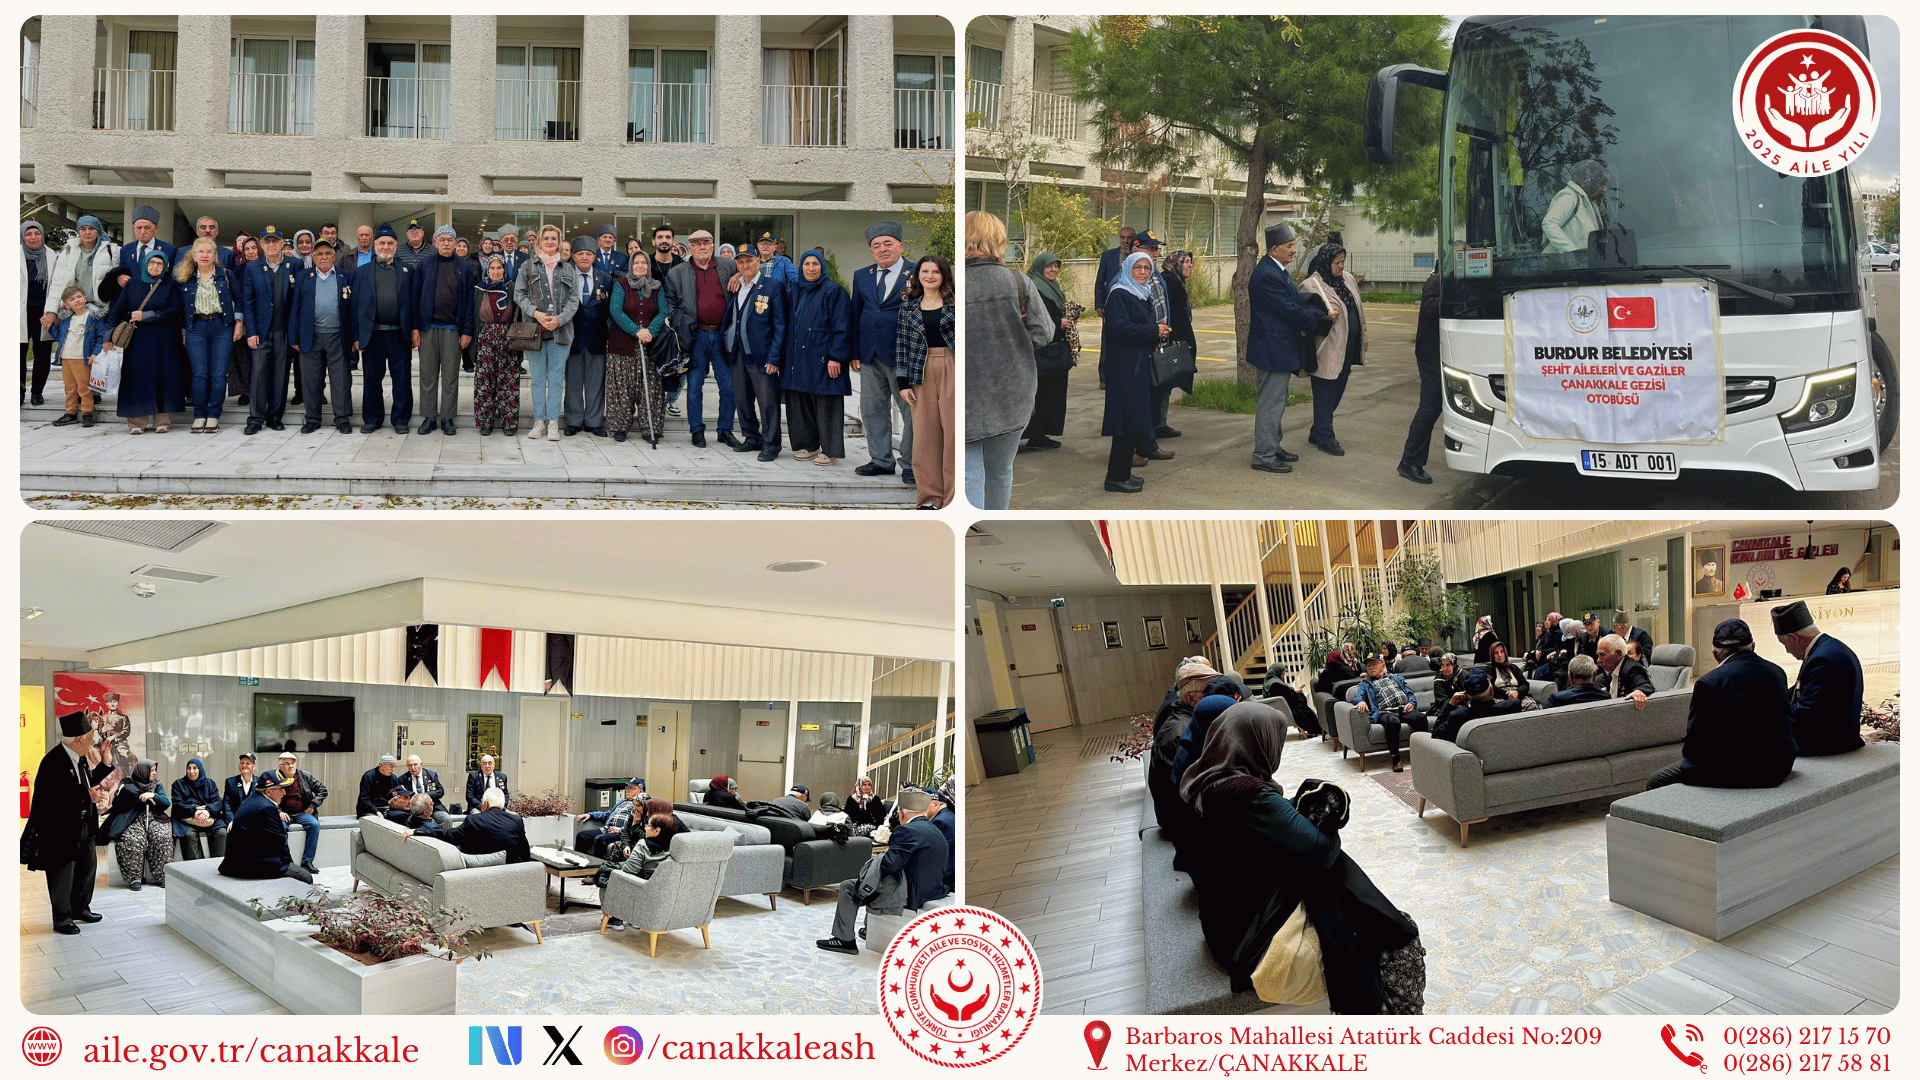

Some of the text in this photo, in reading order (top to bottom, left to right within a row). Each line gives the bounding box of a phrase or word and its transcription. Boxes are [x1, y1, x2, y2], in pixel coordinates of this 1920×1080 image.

[1534, 342, 1693, 361] BURDUR BELEDİYESİ
[1541, 362, 1686, 377] ŞEHİT AİLELERİ VE GAZİLER
[1561, 378, 1666, 391] ÇANAKKALE GEZİSİ
[1587, 392, 1640, 406] OTOBÜSÜ
[1592, 453, 1607, 468] 15
[1615, 454, 1639, 470] ADT
[1647, 455, 1673, 471] 001
